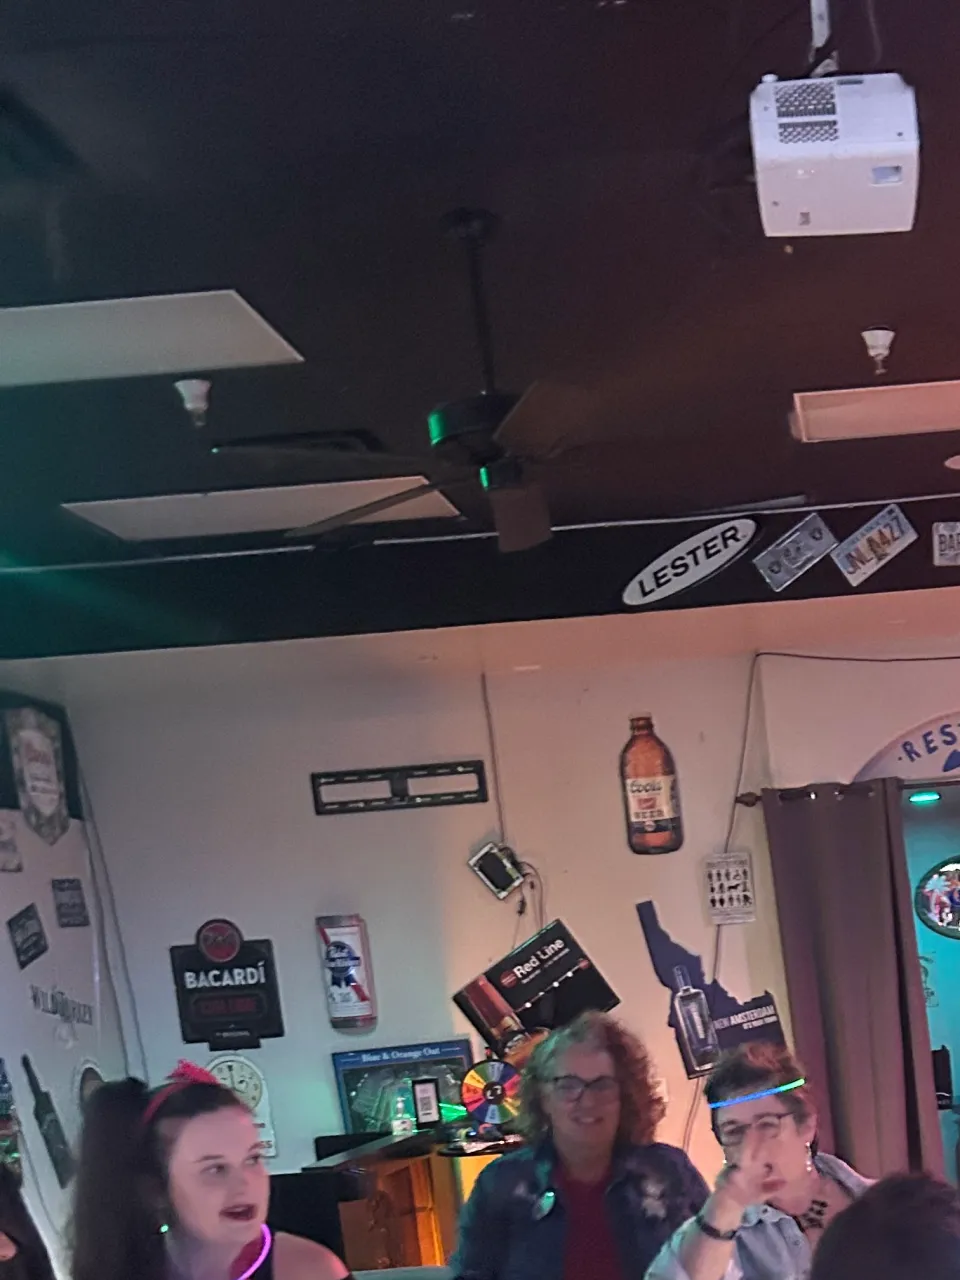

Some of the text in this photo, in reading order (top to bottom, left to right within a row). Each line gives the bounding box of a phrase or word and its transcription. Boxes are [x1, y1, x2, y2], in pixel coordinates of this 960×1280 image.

[637, 525, 742, 597] LESTER
[184, 960, 266, 990] BACARDÍ
[513, 956, 540, 978] Red
[538, 938, 565, 960] Line
[730, 1005, 775, 1025] AMSTERDAM
